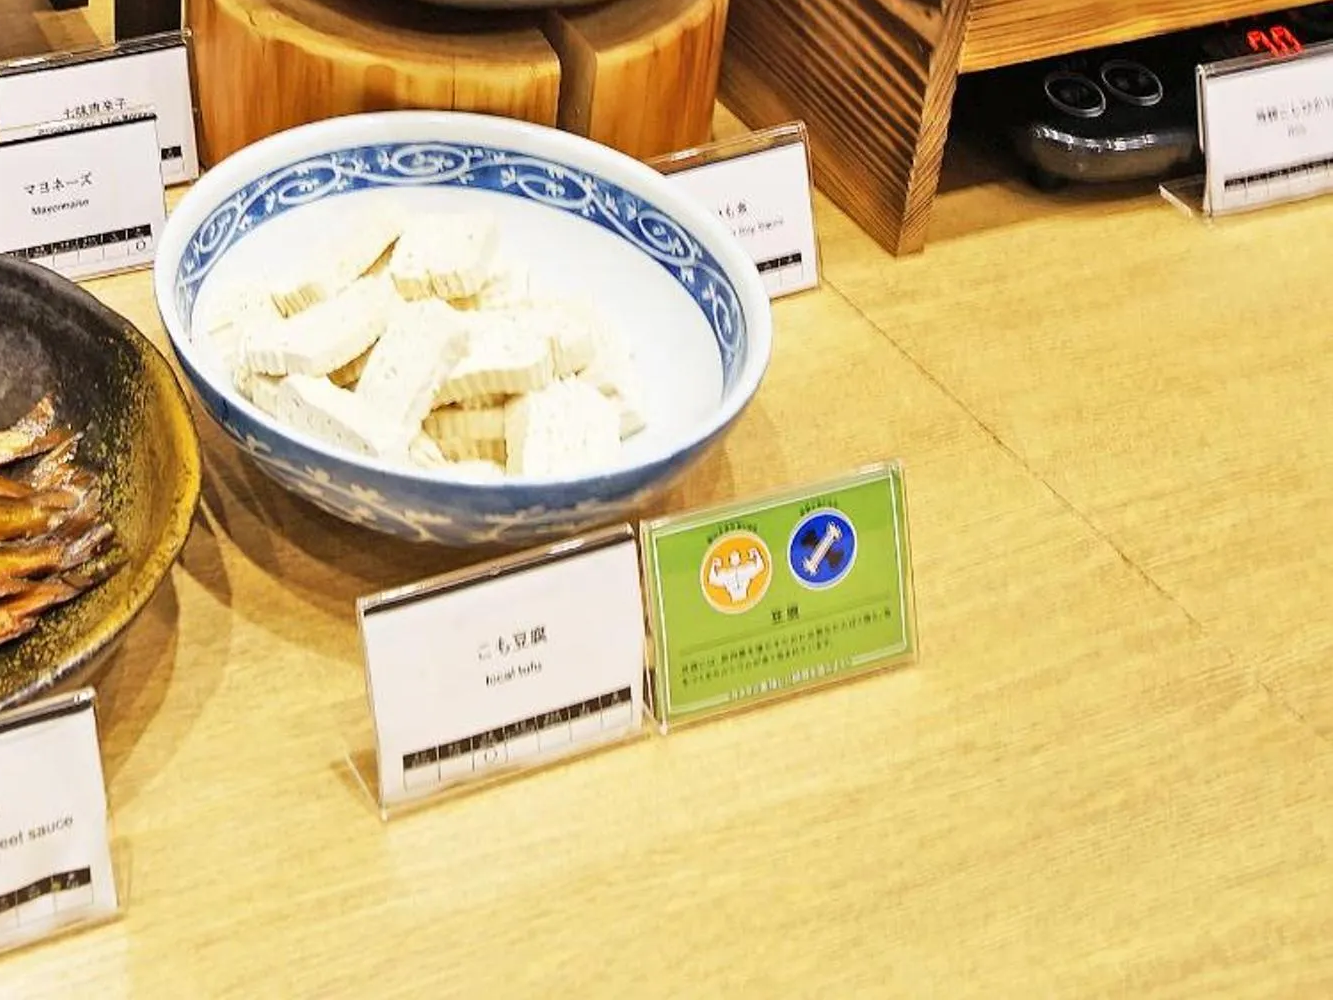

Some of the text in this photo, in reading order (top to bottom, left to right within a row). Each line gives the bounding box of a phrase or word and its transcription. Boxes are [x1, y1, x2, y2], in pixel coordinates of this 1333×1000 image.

[23, 171, 93, 196] マヨネーズ
[27, 814, 74, 841] sauce
